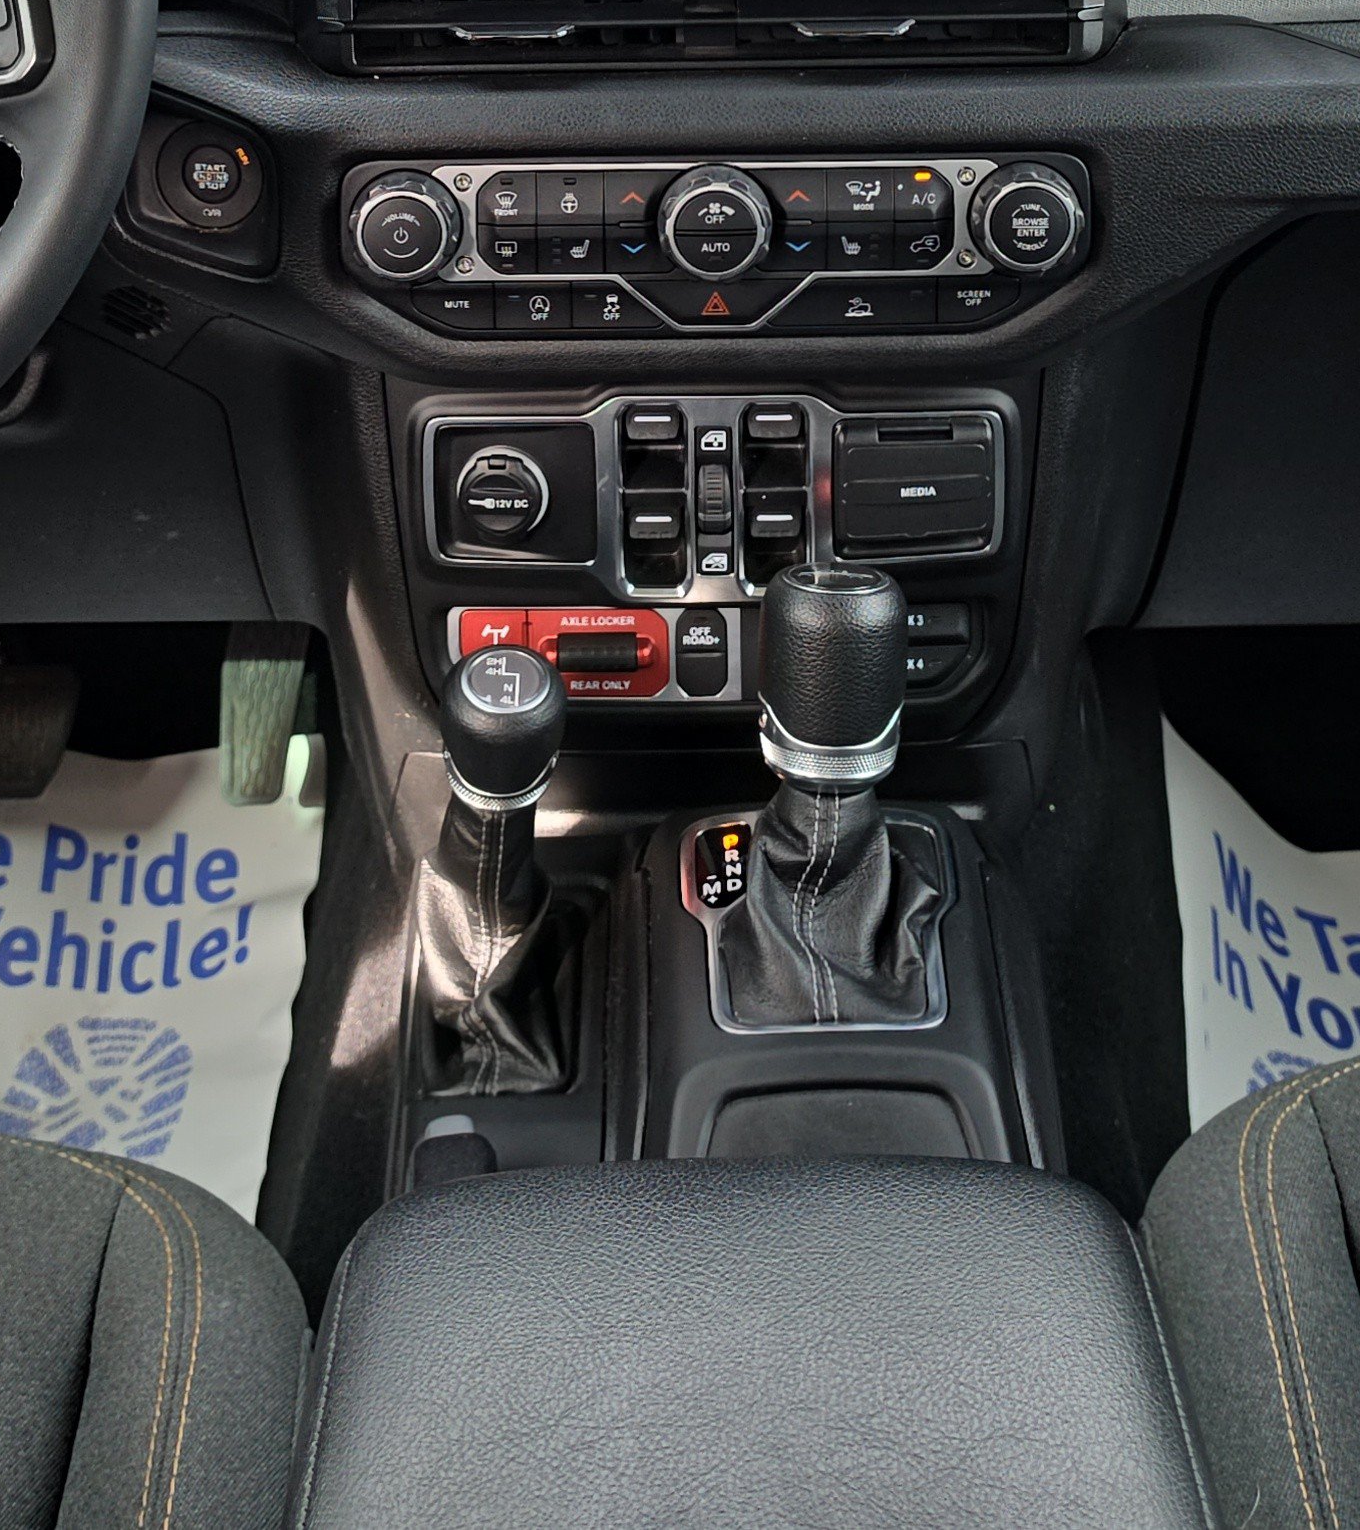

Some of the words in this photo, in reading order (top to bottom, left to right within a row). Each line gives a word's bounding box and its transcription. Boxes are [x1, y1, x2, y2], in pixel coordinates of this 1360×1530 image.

[193, 163, 227, 172] START
[198, 181, 227, 190] STOP
[911, 192, 937, 206] A/C
[852, 202, 875, 212] MODE
[1020, 203, 1042, 212] TUNE
[704, 214, 726, 225] OFF
[1011, 217, 1050, 227] BROWSE
[1016, 228, 1047, 237] ENTER
[700, 241, 731, 253] AUTO
[956, 289, 992, 299] SCREEN
[444, 299, 470, 310] MUTE
[964, 297, 982, 307] OFF
[531, 312, 549, 321] OFF
[603, 312, 621, 321] OFF
[900, 485, 937, 498] MEDIA
[495, 499, 512, 509] 12V
[513, 499, 529, 509] DC
[560, 615, 590, 627] AXLE
[590, 615, 636, 626] LOCKER
[688, 626, 712, 636] OFF
[485, 667, 501, 676] 4H
[503, 683, 514, 692] N
[570, 679, 601, 691] REAR
[601, 679, 631, 691] ONLY
[500, 695, 514, 704] 4L
[723, 834, 739, 850] P
[724, 849, 740, 863] R
[40, 824, 240, 909] Pride
[726, 863, 742, 877] N
[702, 880, 722, 897] M
[726, 878, 743, 892] D
[1212, 831, 1290, 958] We
[1210, 905, 1255, 1013] In
